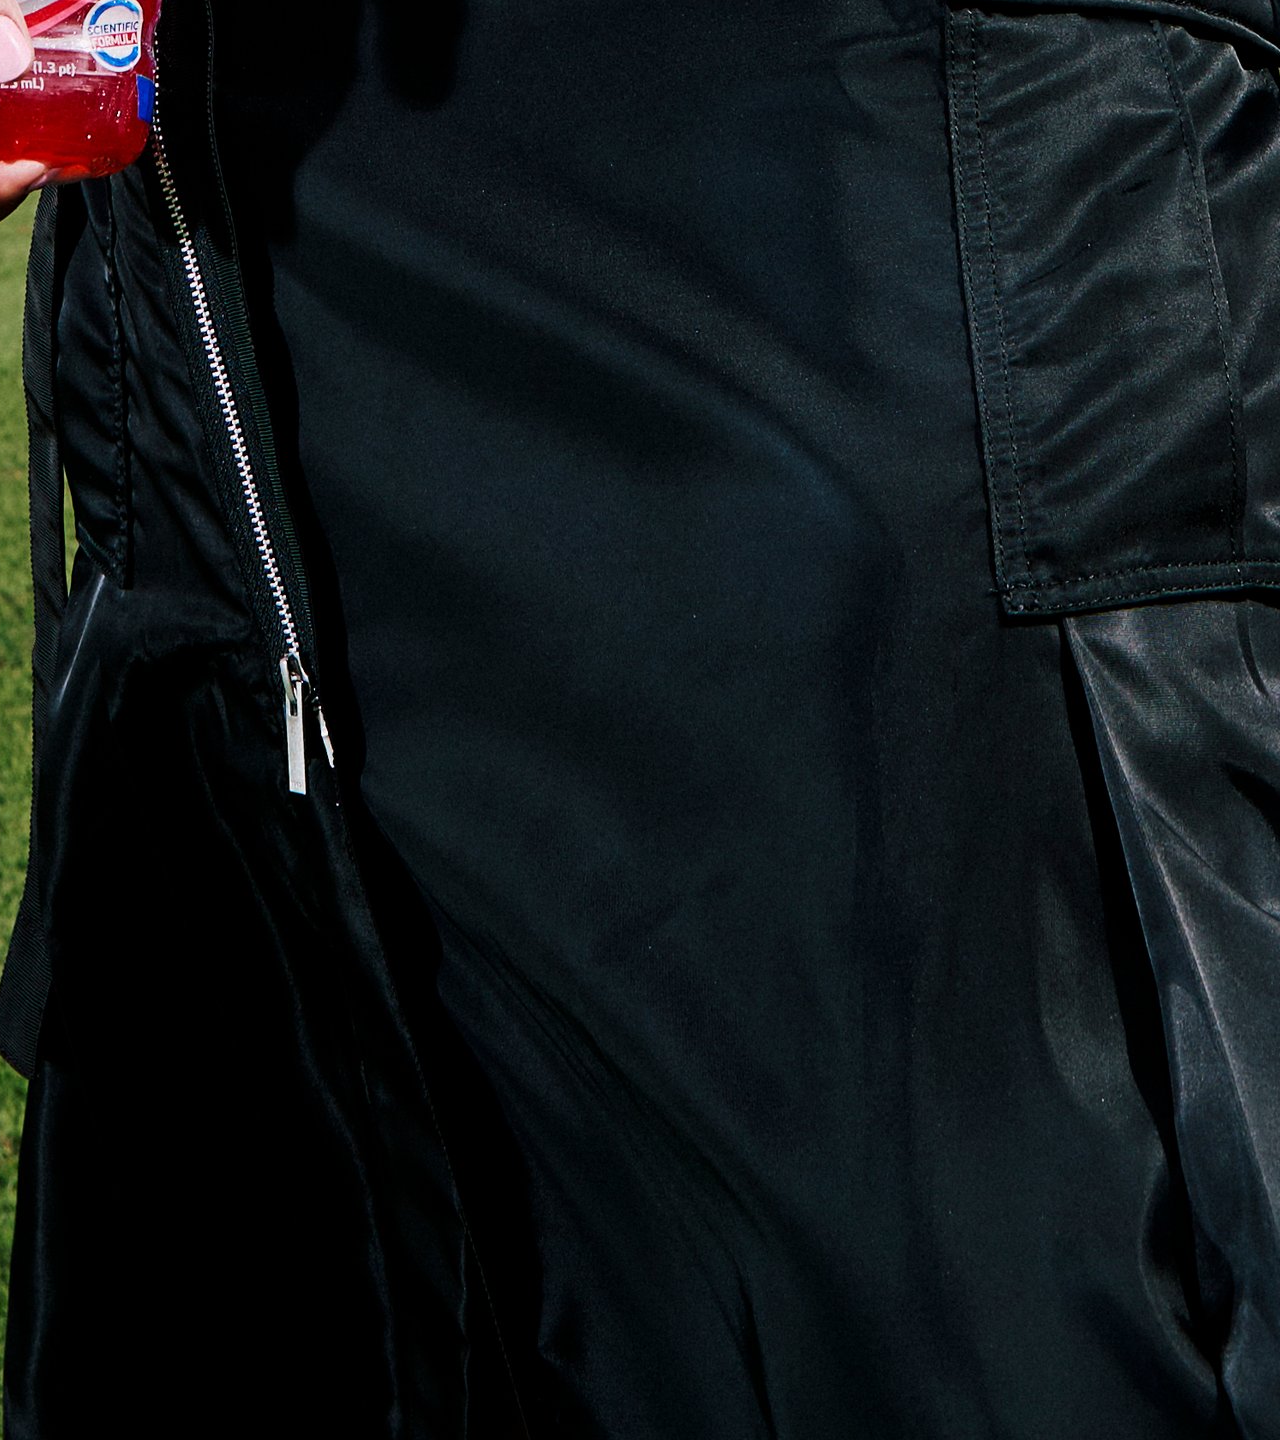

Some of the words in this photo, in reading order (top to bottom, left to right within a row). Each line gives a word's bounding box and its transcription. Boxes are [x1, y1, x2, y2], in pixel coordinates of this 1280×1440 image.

[87, 20, 139, 36] SCIENTIFIC
[91, 32, 138, 50] FORMULA
[32, 60, 56, 75] (1.3
[58, 62, 77, 77] pt)
[20, 76, 45, 91] mL)
